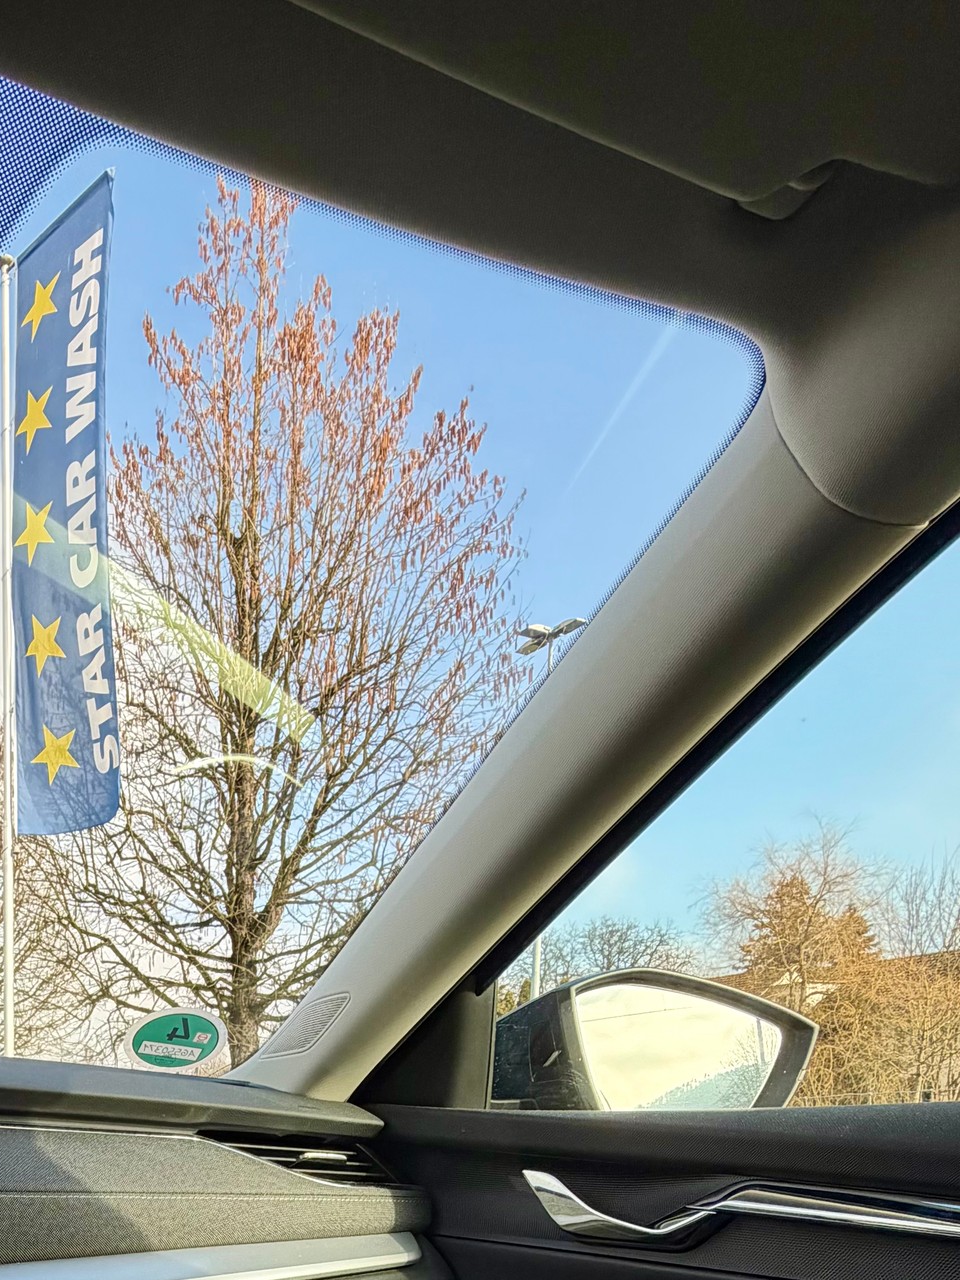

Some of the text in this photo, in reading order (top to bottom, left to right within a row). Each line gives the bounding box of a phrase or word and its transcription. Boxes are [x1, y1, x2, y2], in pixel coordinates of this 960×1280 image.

[65, 227, 120, 775] STAR CAR WASH
